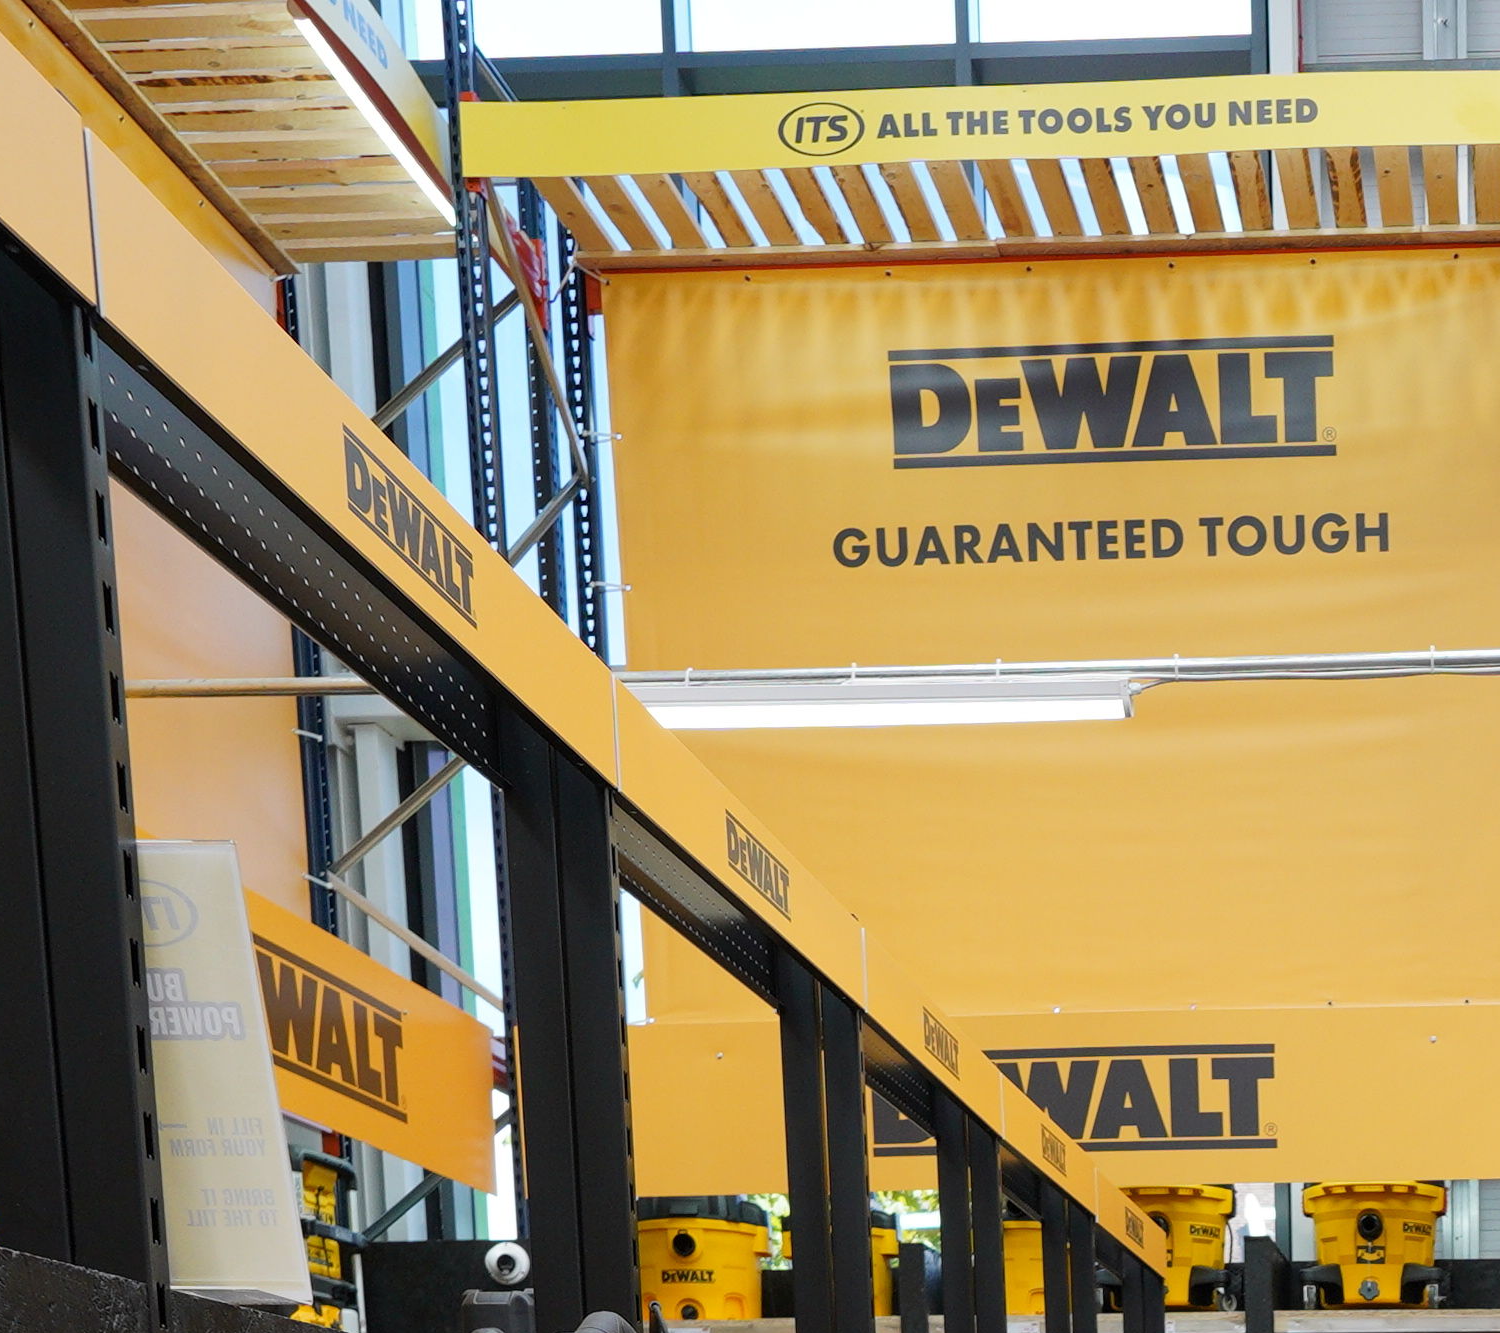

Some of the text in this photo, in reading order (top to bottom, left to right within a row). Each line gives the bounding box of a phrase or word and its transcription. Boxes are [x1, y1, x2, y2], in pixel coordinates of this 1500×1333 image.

[794, 98, 1318, 143] ITS ALL THE TOOLS YOU NEED
[833, 512, 1389, 569] GUARANTEED TOUGH
